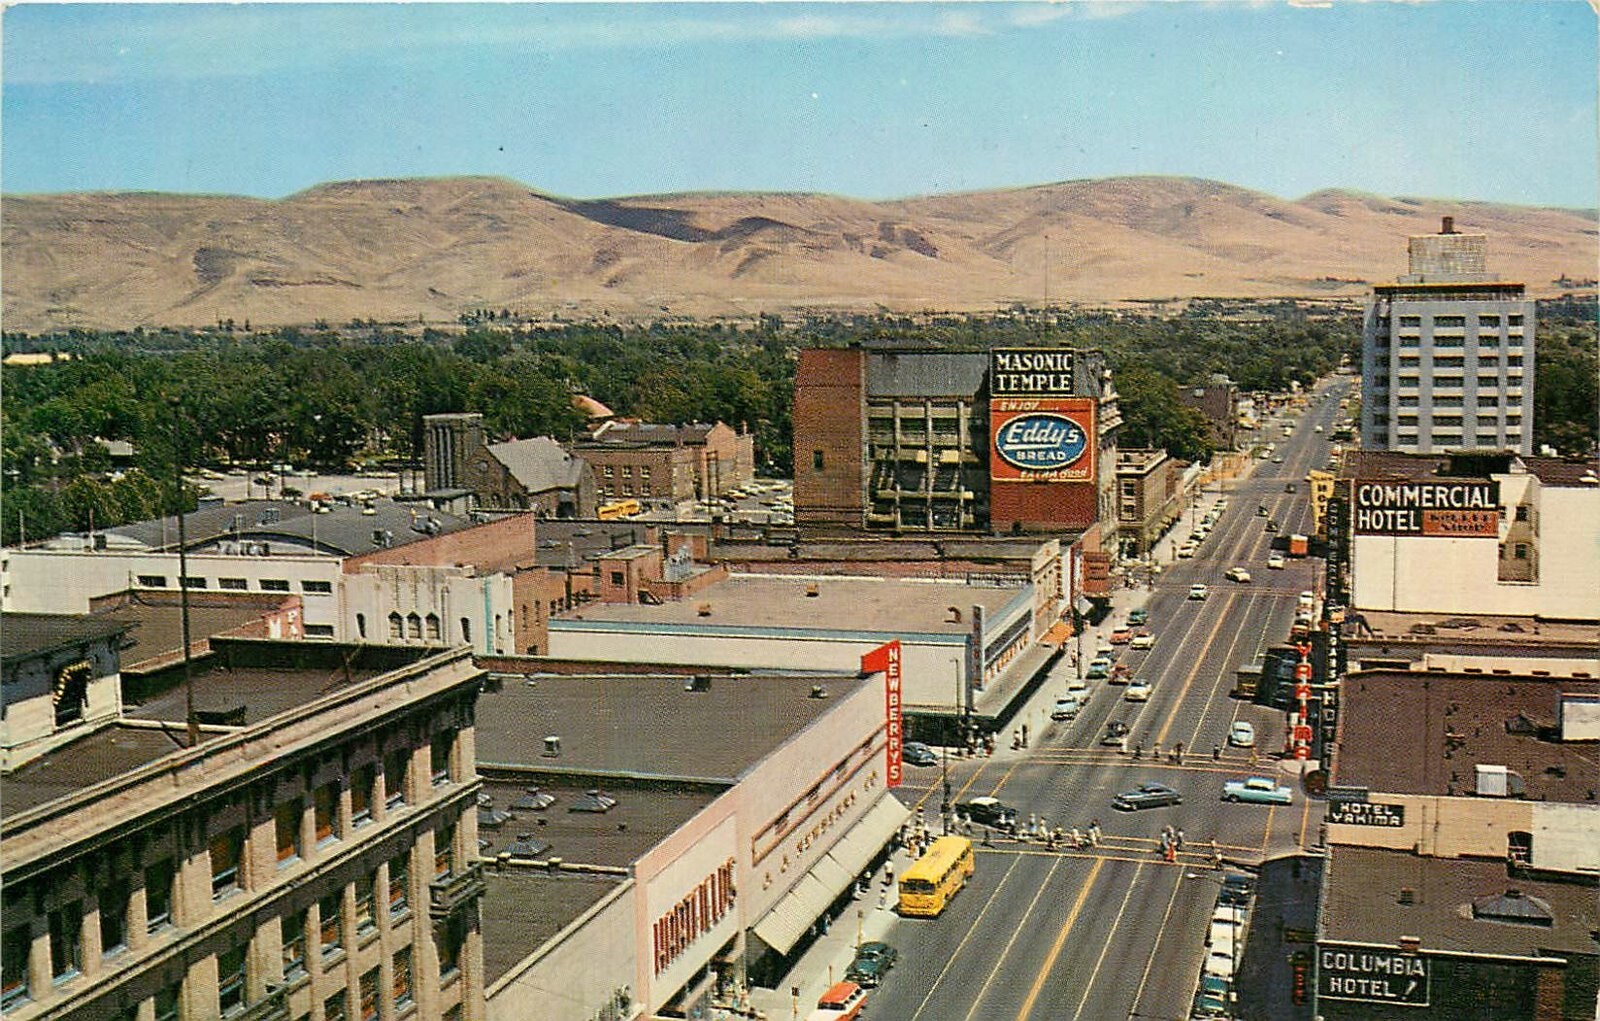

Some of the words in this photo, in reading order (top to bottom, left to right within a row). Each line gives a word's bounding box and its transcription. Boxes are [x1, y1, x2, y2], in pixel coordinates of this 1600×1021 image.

[996, 353, 1073, 371] MASONIC
[996, 374, 1072, 391] TEMPLE
[1016, 451, 1066, 461] BREAD
[1359, 485, 1497, 508] COMMERCIAL
[1358, 509, 1420, 531] HOTEL
[889, 649, 900, 779] NEWBERRYS
[1340, 802, 1393, 815] HOTEL
[1332, 812, 1401, 826] YAKIMA
[1322, 952, 1425, 977] COLUMBIA
[1330, 977, 1397, 998] HOTEL
